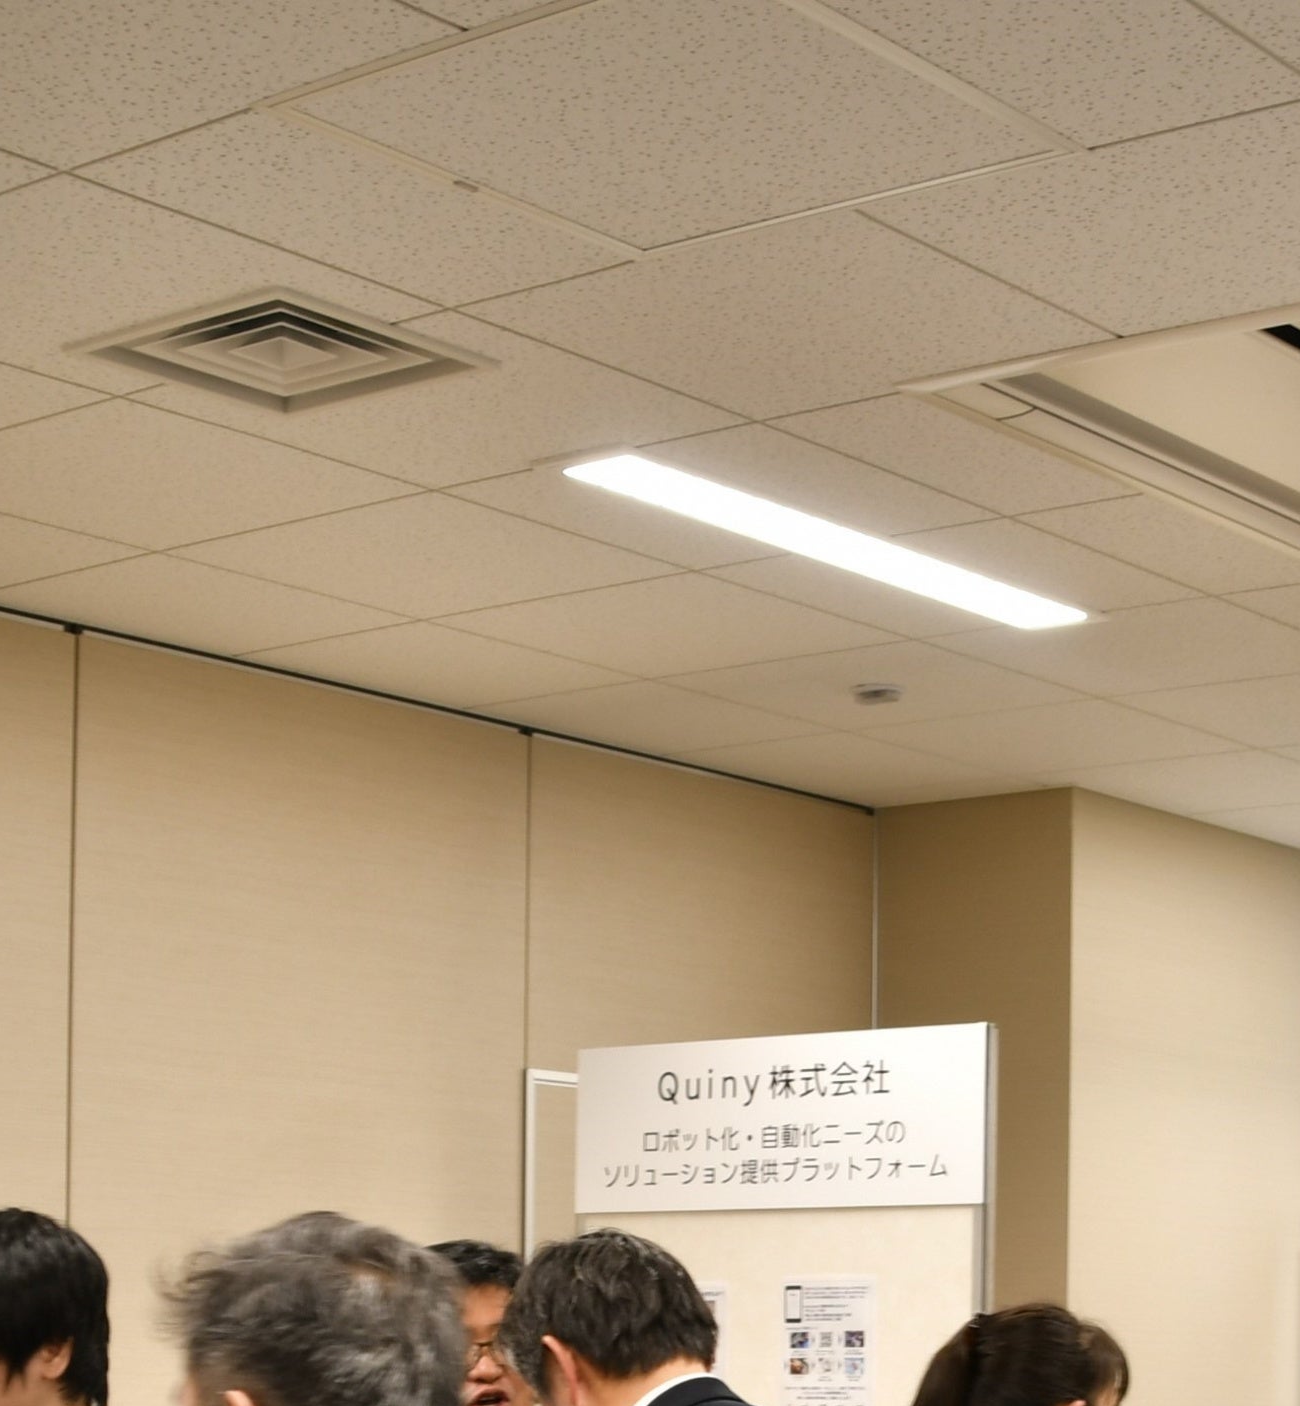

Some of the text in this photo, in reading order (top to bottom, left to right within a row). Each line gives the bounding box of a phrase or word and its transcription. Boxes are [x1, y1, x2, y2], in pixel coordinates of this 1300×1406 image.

[657, 1058, 891, 1107] Quiny株式会社
[642, 1119, 907, 1154] ロボット化・自動化ニーズの
[603, 1153, 949, 1189] ソリューション提供プラットフォーム
